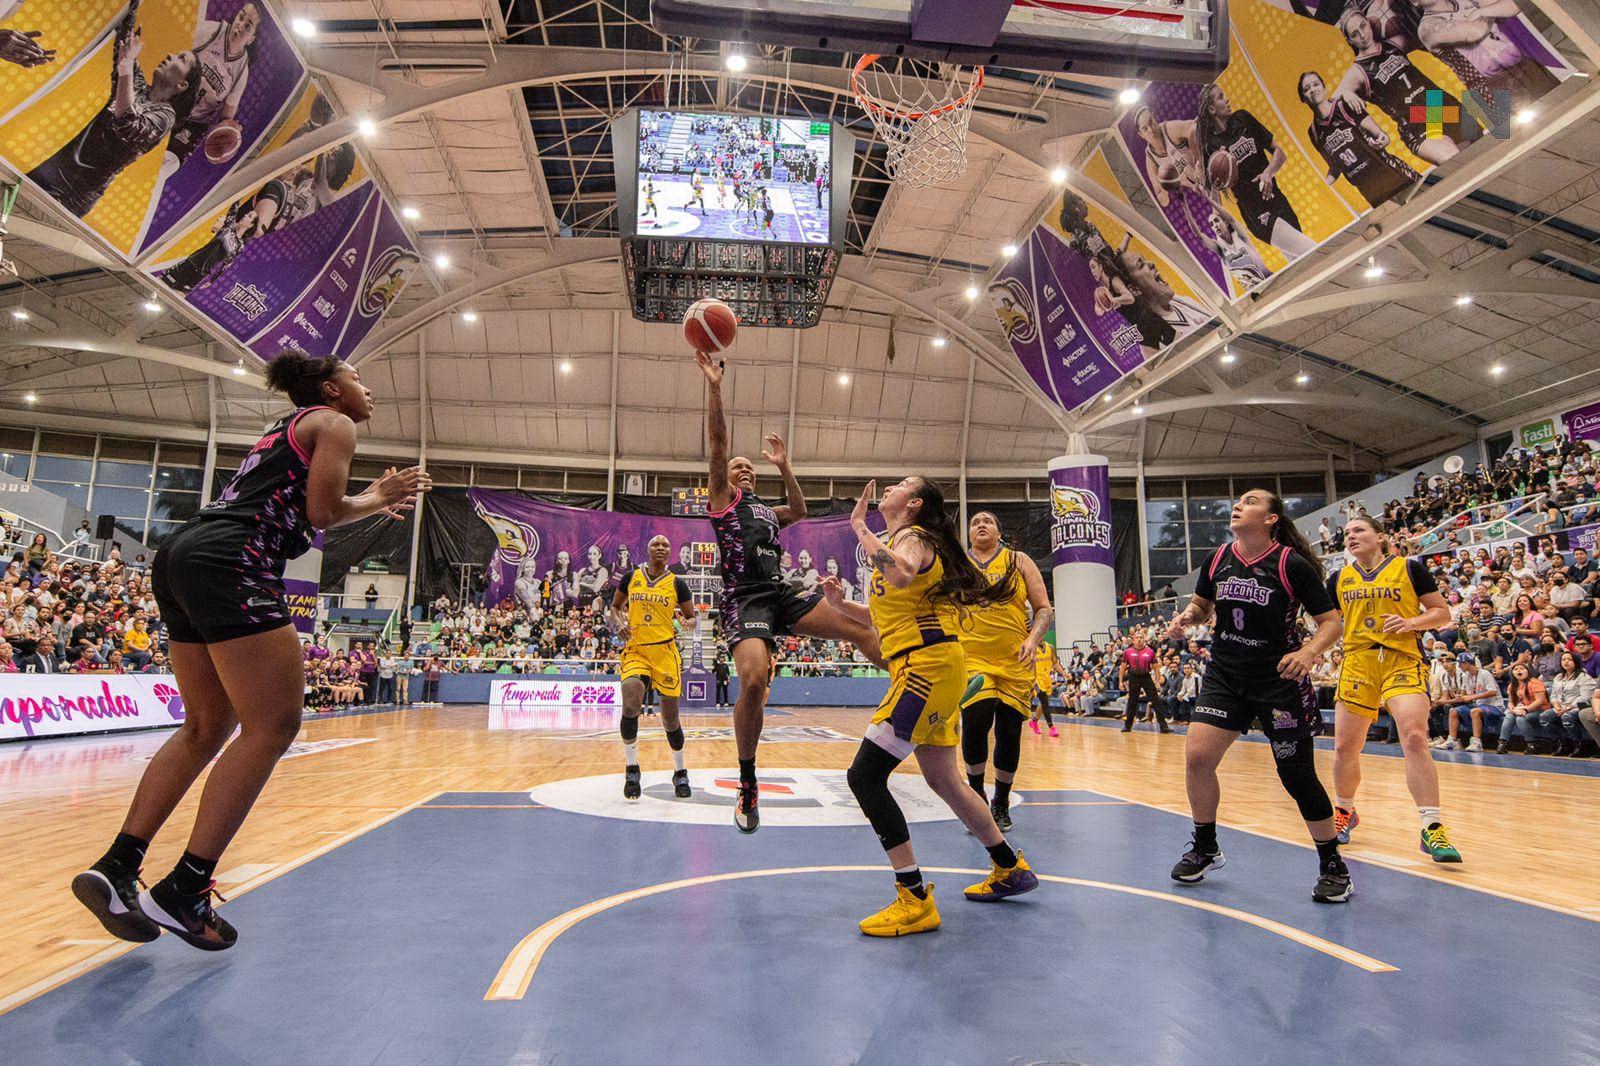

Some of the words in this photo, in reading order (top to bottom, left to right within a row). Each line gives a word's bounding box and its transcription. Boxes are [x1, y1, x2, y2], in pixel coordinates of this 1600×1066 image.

[1398, 73, 1411, 88] 7
[1339, 149, 1358, 166] 30
[1051, 523, 1109, 549] HALCONES
[701, 553, 712, 567] 14
[1218, 583, 1268, 605] HALCONES
[1232, 607, 1244, 631] 8
[501, 682, 561, 704] Temporada
[572, 685, 615, 704] 2022
